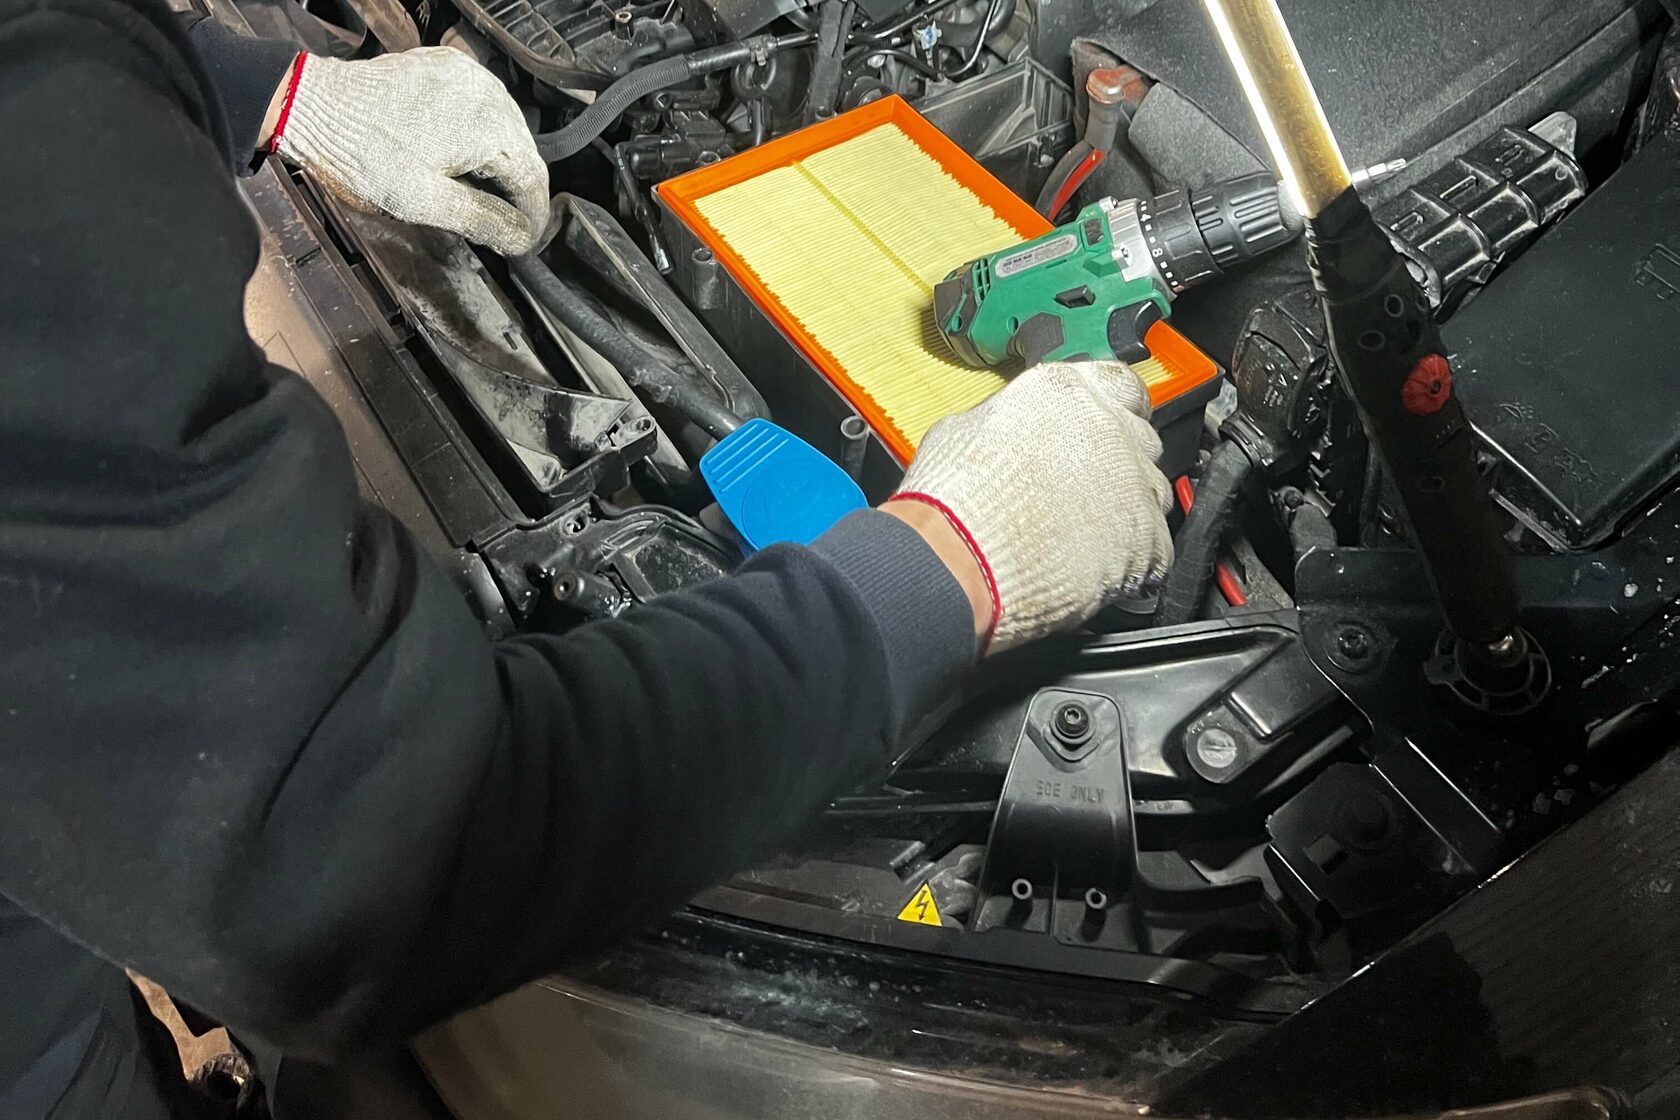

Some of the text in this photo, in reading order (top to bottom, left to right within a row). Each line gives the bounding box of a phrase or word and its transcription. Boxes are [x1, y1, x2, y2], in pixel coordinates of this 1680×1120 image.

[1140, 213, 1151, 222] 4
[1151, 247, 1163, 258] 8
[1070, 785, 1105, 804] ONLY
